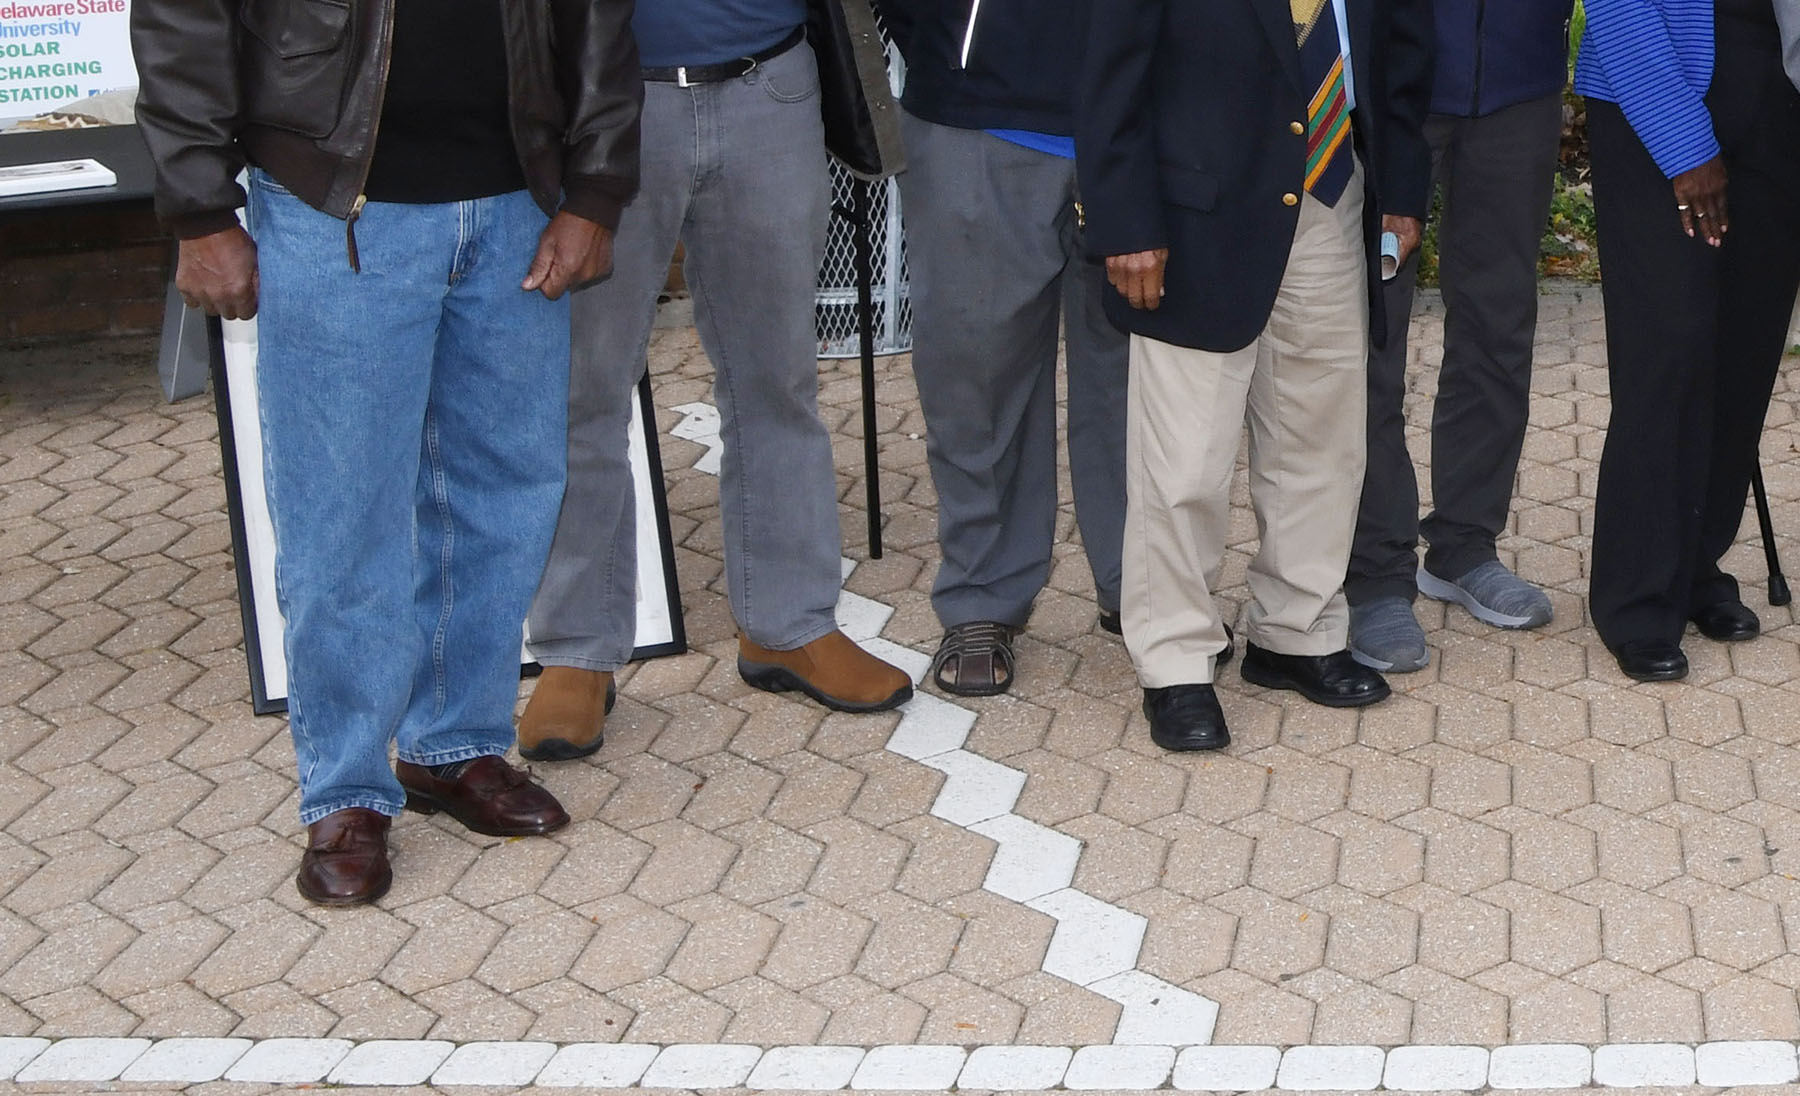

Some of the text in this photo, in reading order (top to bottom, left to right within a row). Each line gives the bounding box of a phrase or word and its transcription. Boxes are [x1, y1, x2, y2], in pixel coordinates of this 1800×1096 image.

[0, 2, 74, 19] elaware
[0, 61, 102, 81] CHARGING
[0, 84, 78, 103] STATION
